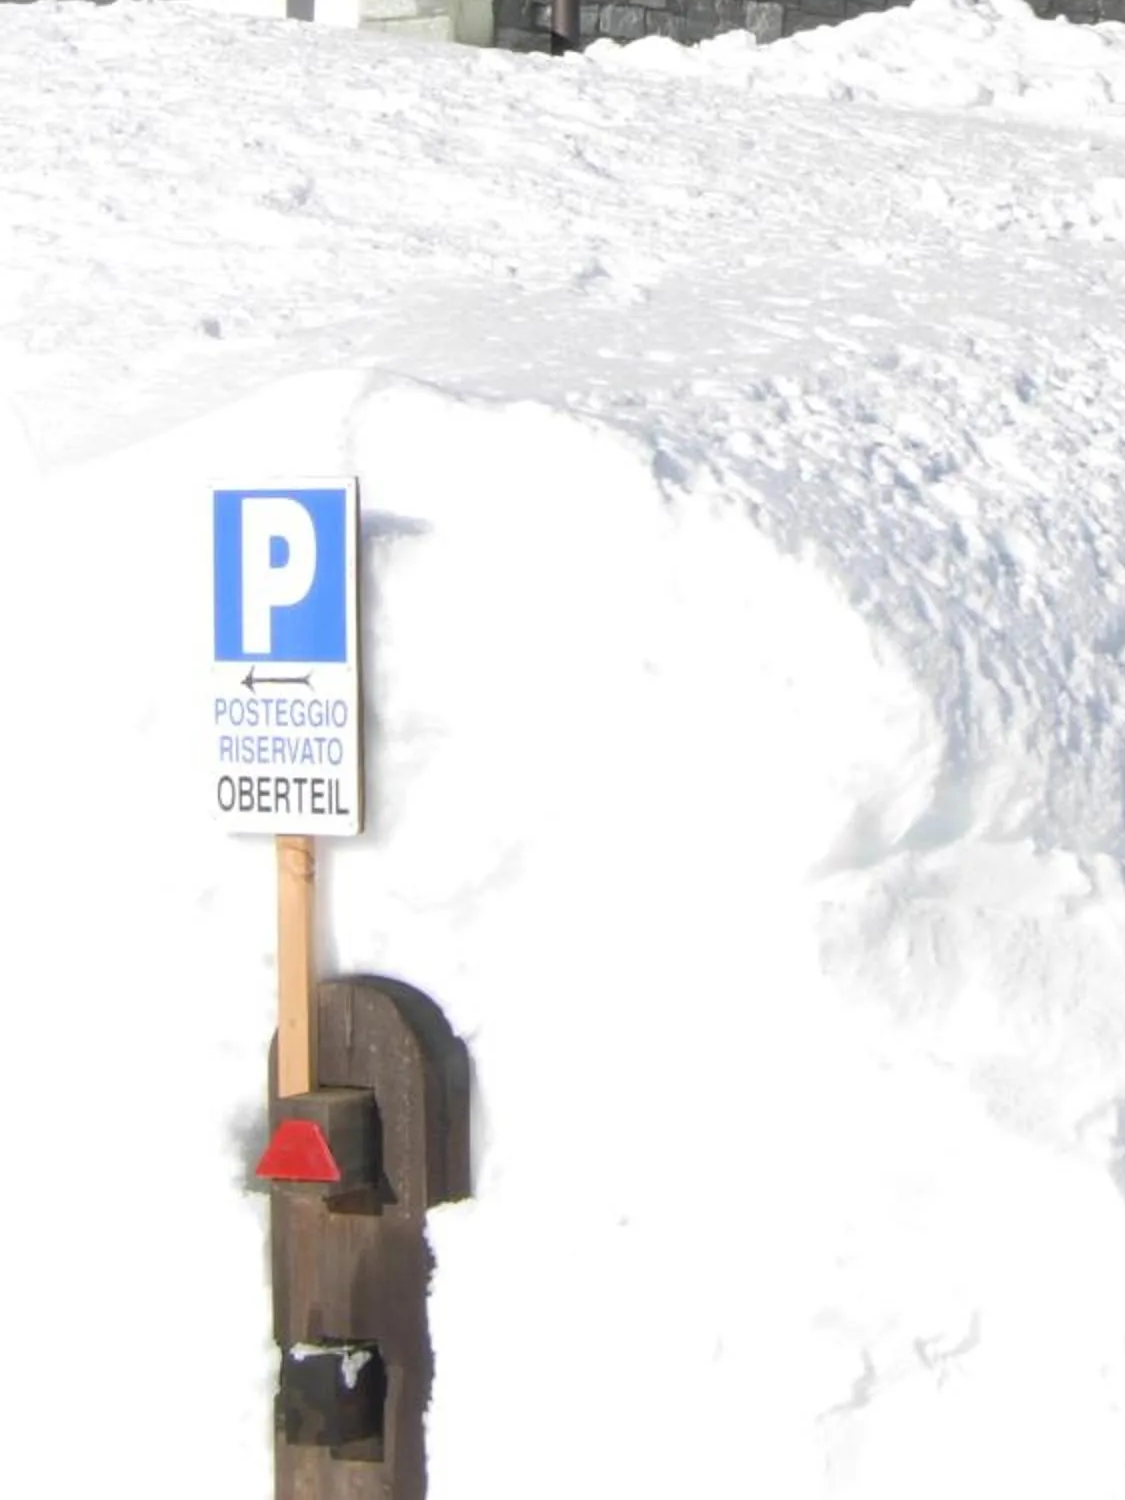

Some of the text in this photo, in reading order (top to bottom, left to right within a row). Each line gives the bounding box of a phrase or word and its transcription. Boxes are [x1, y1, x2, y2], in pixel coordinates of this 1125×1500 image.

[241, 497, 317, 654] P
[214, 698, 348, 728] POSTEGGIO
[219, 736, 344, 766] RISERVATO
[217, 775, 350, 816] OBERTEIL
